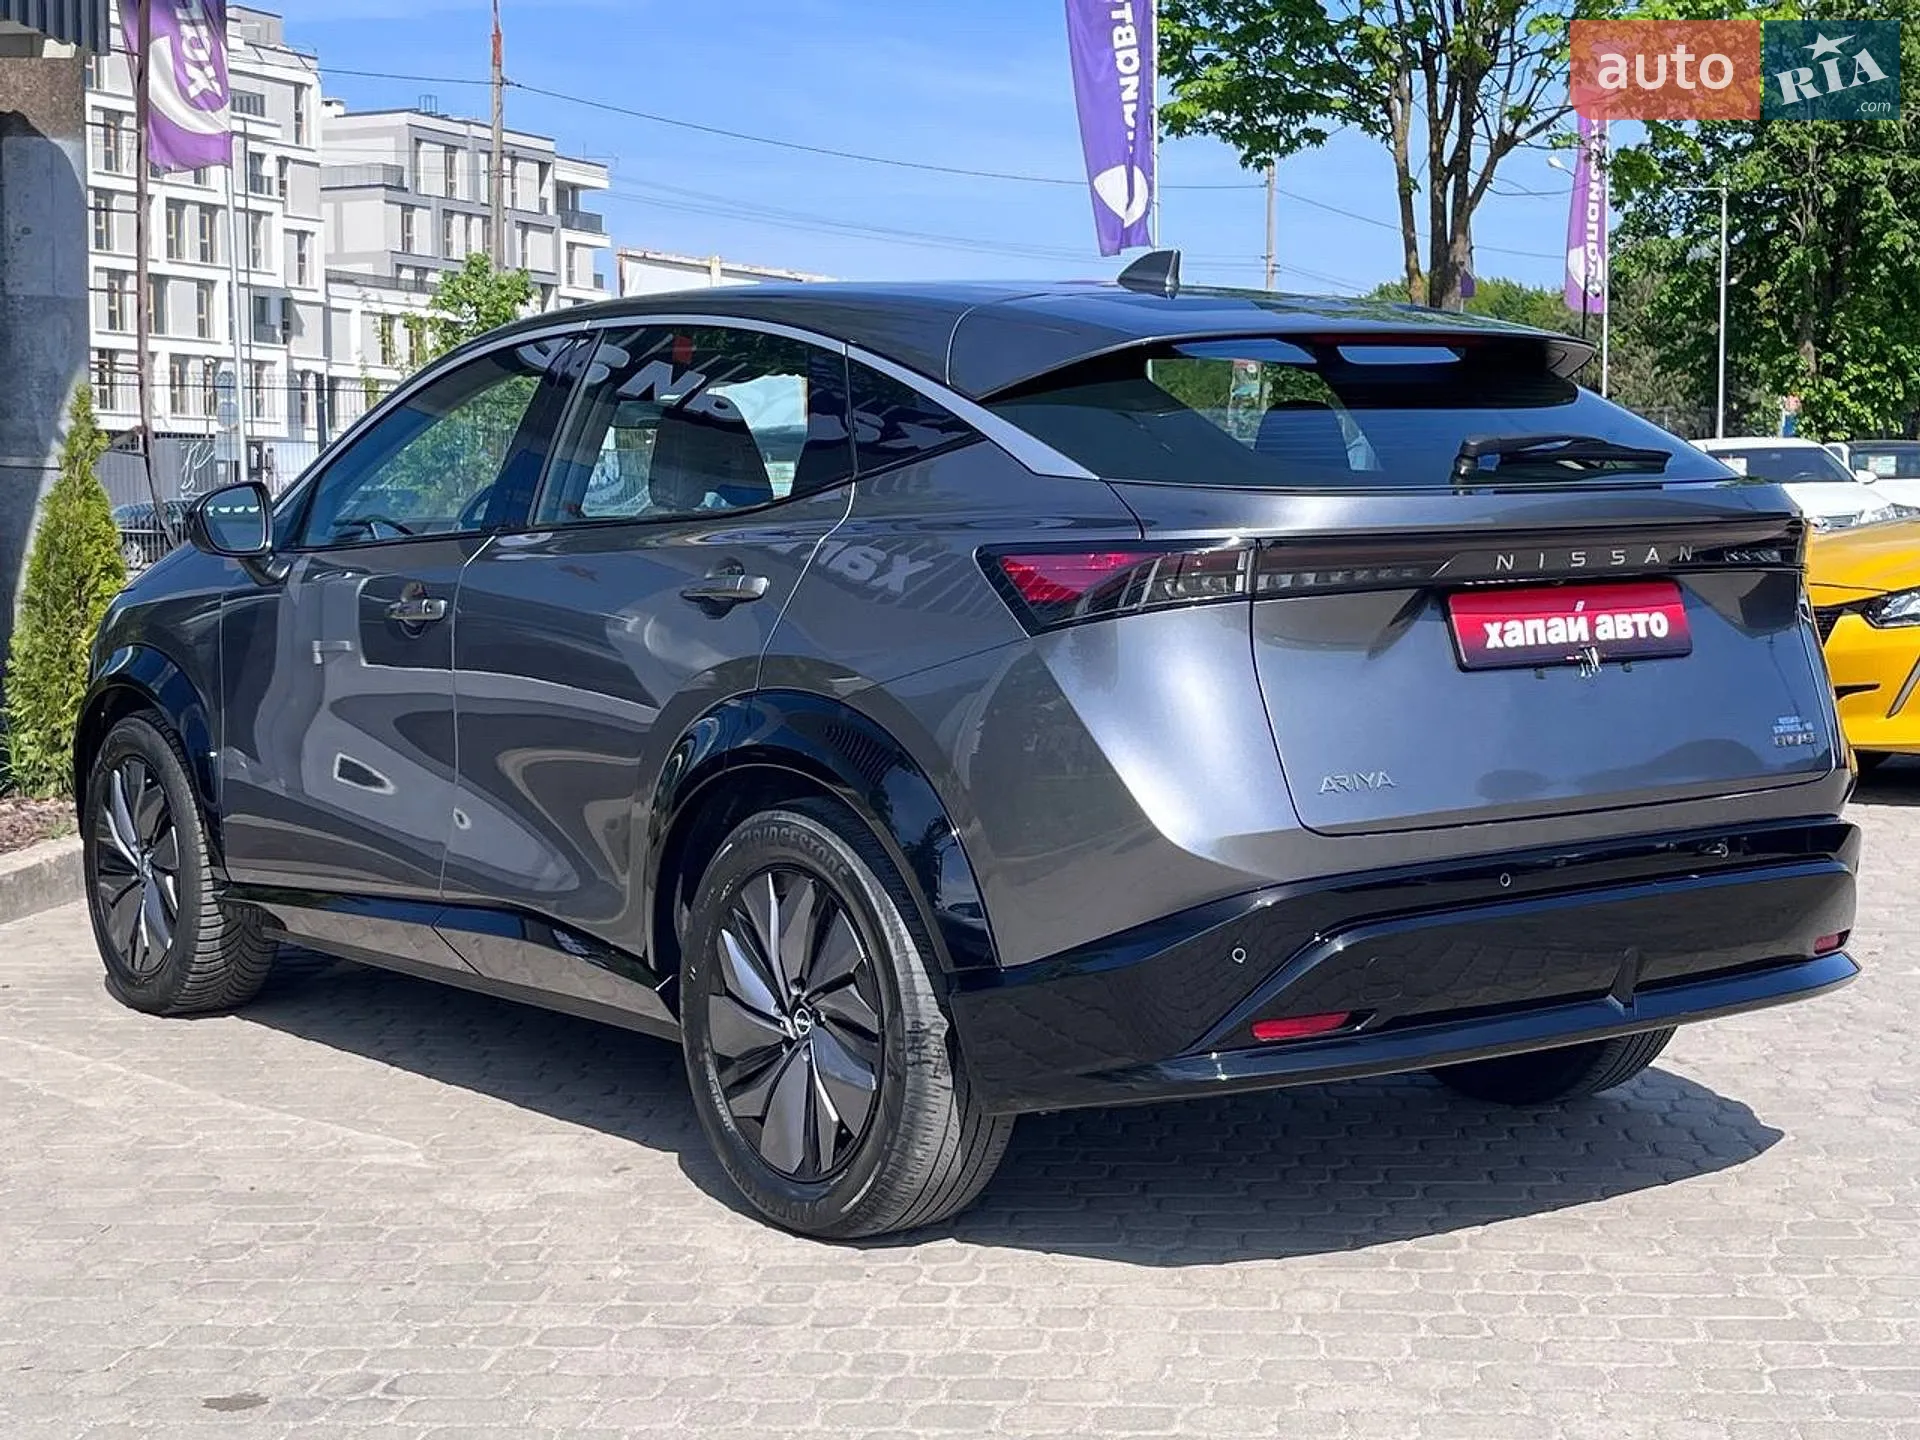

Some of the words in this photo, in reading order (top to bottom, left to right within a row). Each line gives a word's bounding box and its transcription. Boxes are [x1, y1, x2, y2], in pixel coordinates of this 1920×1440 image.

[1496, 546, 1693, 571] NISSAN
[1483, 600, 1590, 649] хапай
[1595, 611, 1669, 640] авто
[1319, 771, 1398, 793] ARIYA
